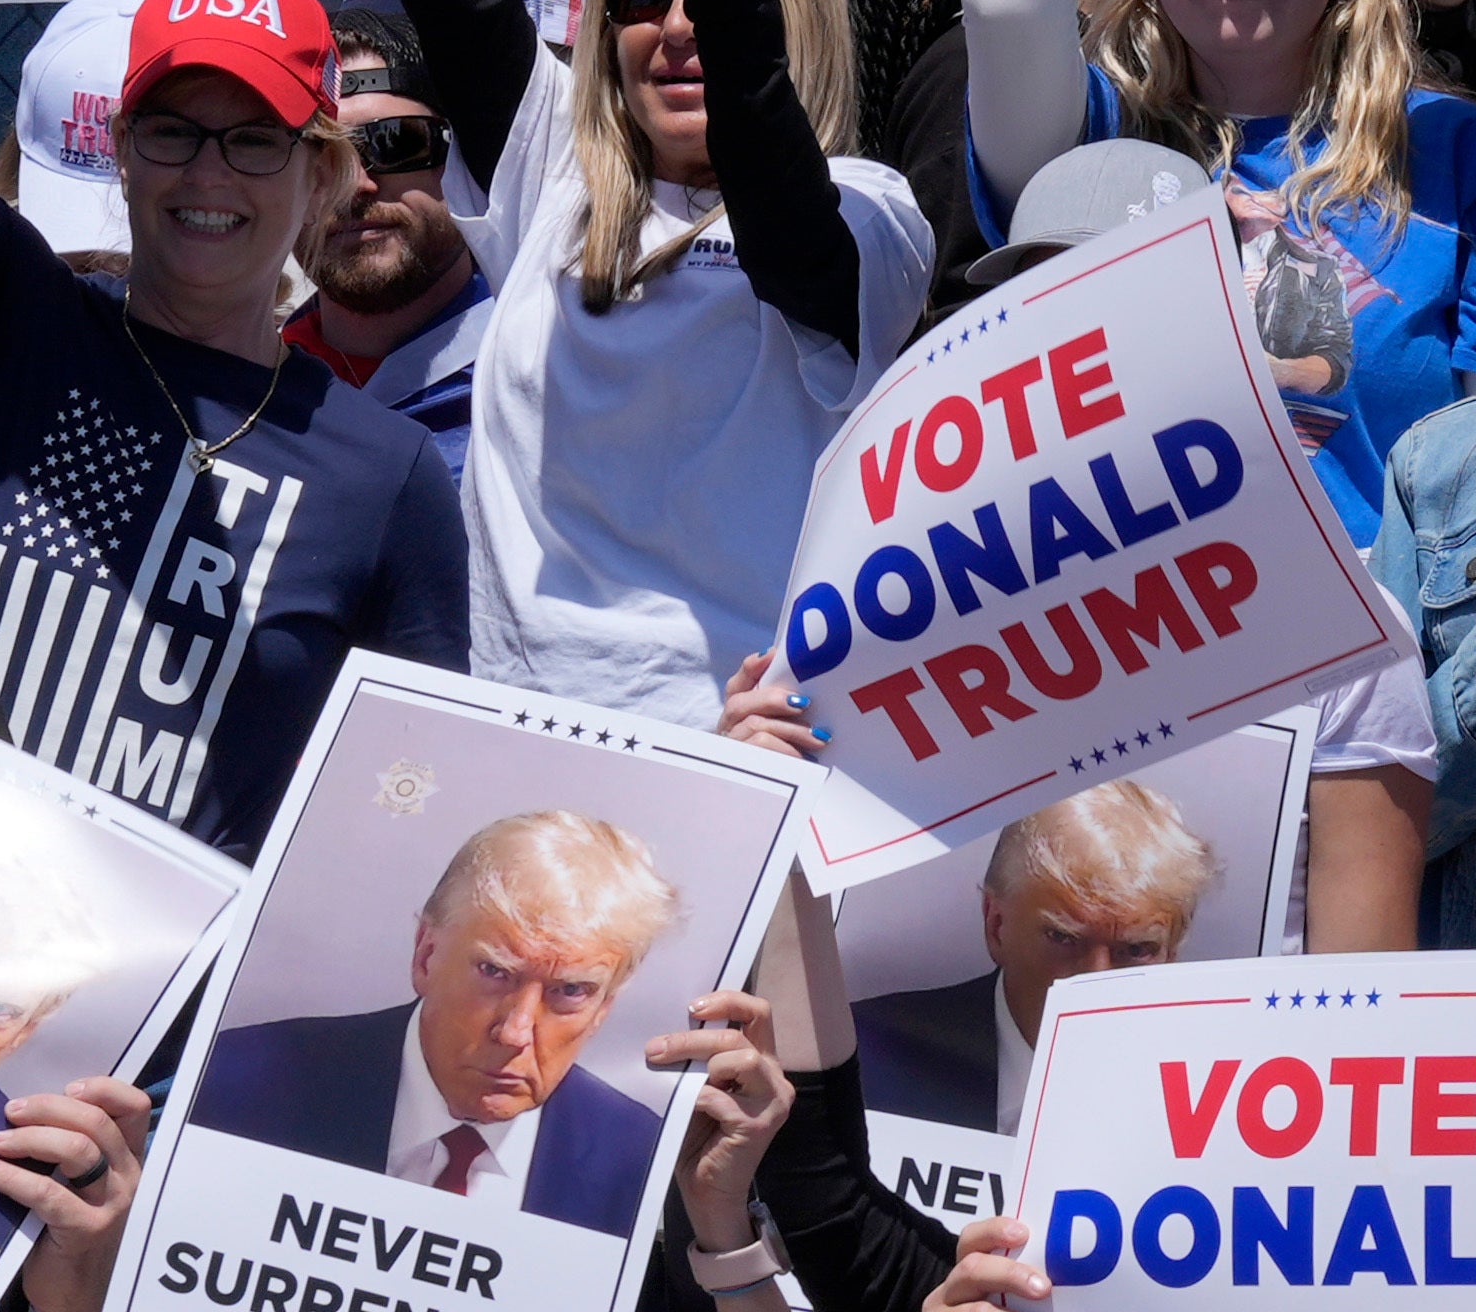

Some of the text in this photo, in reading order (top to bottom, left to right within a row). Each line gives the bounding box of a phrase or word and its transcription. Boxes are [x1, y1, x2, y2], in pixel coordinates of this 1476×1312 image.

[859, 326, 1127, 526] VOTE
[787, 417, 1245, 684] DONALD
[850, 541, 1259, 762] TRUMP
[270, 1192, 504, 1301] NEVER
